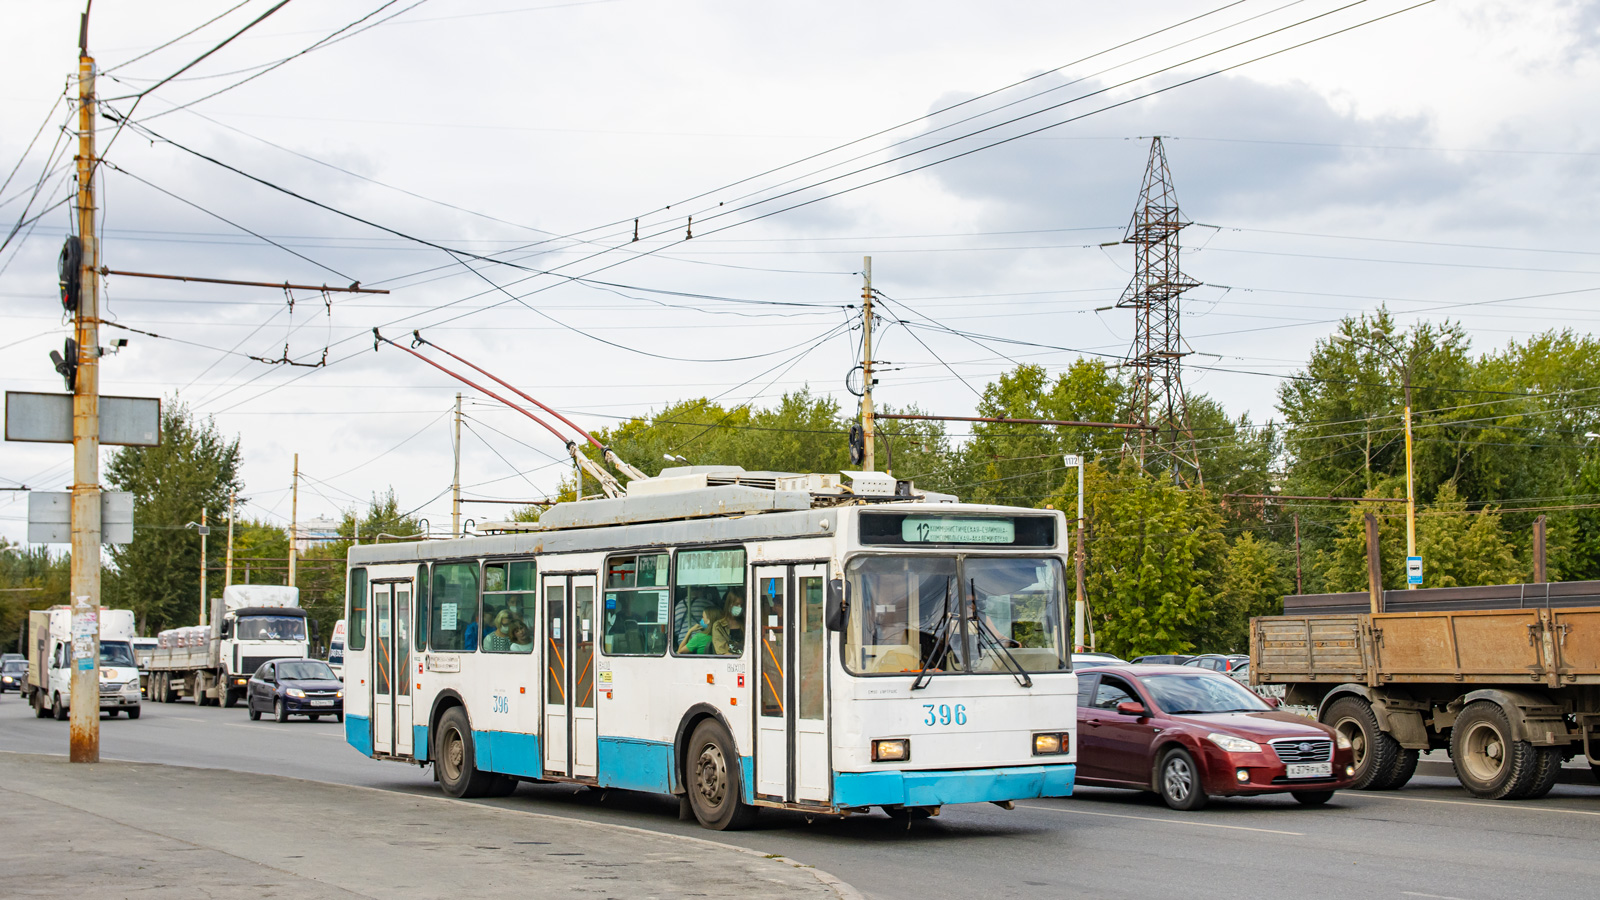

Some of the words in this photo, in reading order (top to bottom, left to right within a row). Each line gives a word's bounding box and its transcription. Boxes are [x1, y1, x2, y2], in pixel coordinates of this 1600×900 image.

[1065, 457, 1078, 465] 1172
[917, 522, 930, 542] 12
[492, 695, 509, 714] 396
[922, 703, 967, 727] 396
